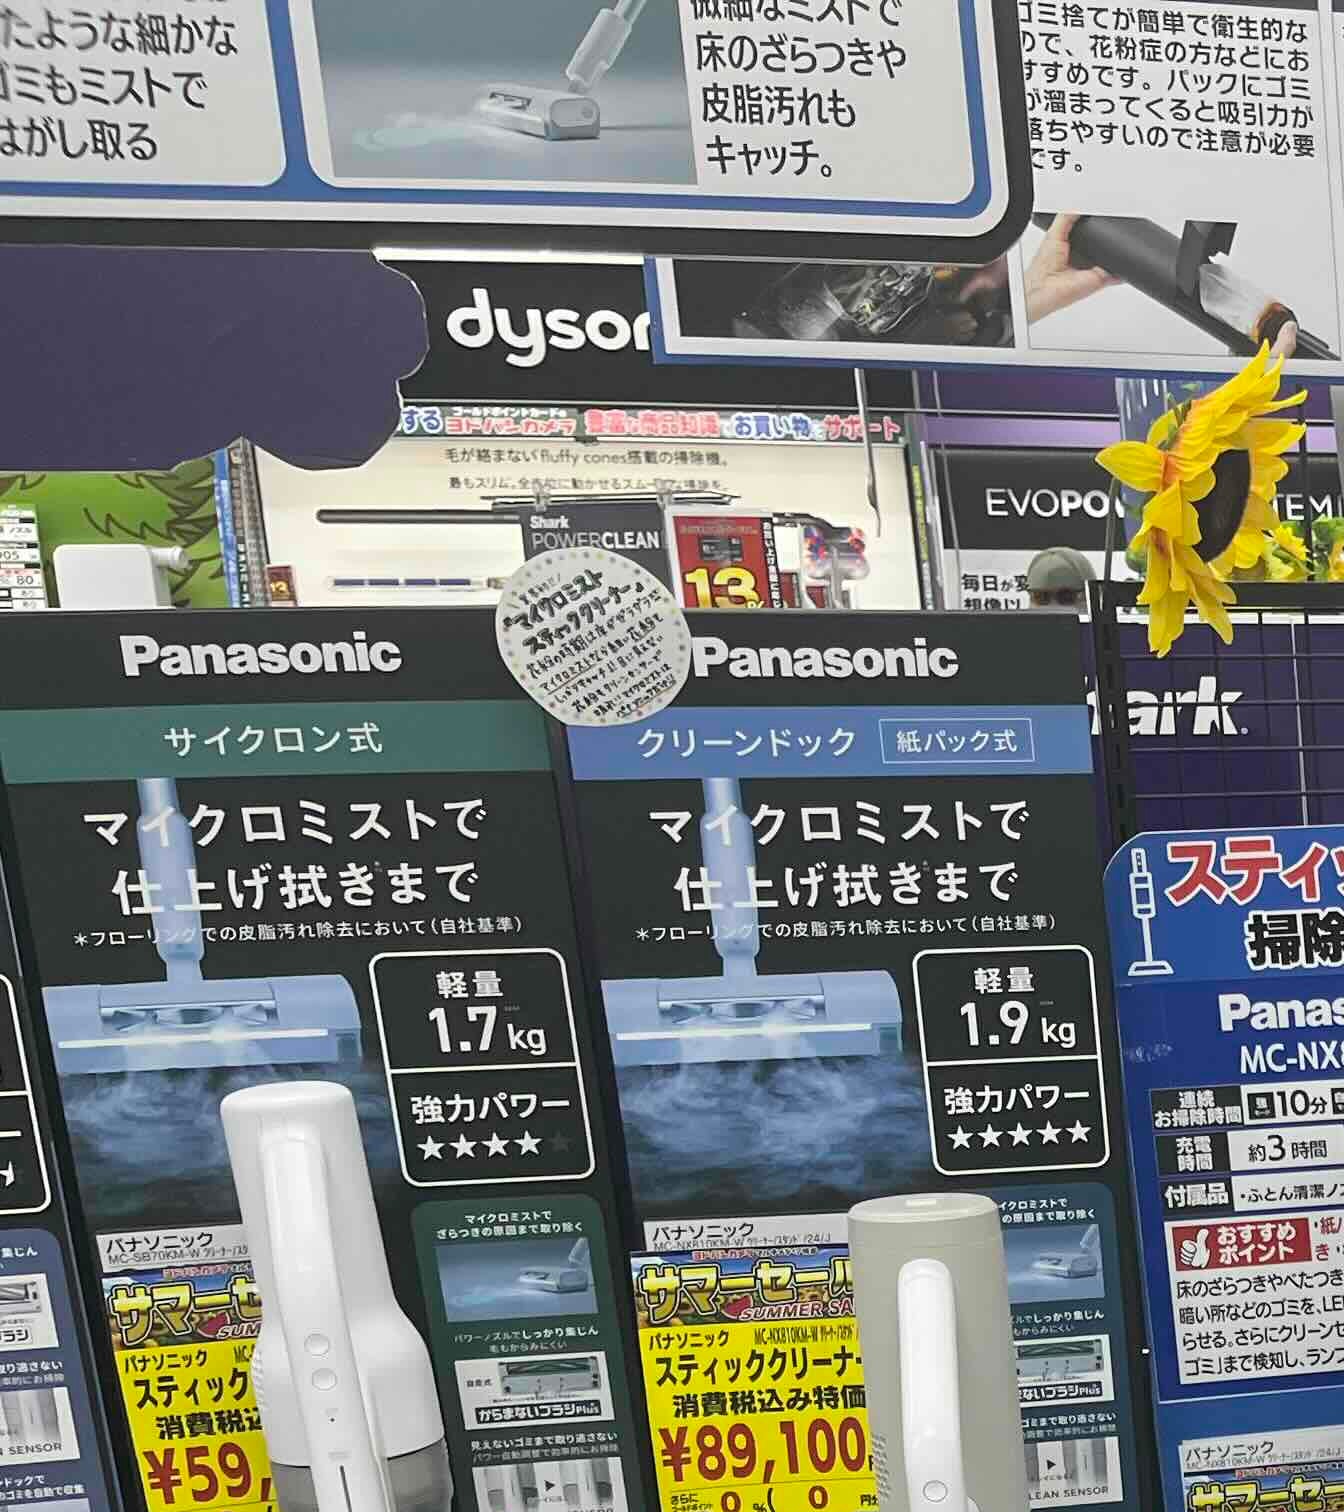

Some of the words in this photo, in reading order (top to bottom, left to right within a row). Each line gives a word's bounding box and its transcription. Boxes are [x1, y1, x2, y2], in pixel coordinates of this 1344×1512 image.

[697, 34, 906, 79] 床のざらつきや
[702, 83, 856, 128] 皮脂汚れも
[707, 135, 833, 179] キャッチ。
[119, 632, 402, 678] Panasonic
[692, 637, 959, 679] Panasonic
[163, 722, 383, 757] サイクロン式
[637, 726, 856, 759] クリーンドック
[896, 726, 1018, 753] 紙パック式
[83, 798, 489, 849] マイクロミストで
[648, 800, 1029, 845] マイクロミストで
[112, 860, 480, 917] 仕上げ拭きまで
[673, 861, 1019, 912] 仕上げ拭きまで
[436, 970, 504, 998] 軽量
[973, 966, 1035, 994] 軽量
[428, 1005, 500, 1053] 1.7
[508, 1023, 546, 1056] kg
[959, 1000, 1030, 1047] 1.9
[1040, 1017, 1075, 1047] kg
[411, 1092, 570, 1124] 強力パワー
[943, 1086, 1090, 1115] 強力パワー
[1178, 1091, 1215, 1109] 連続
[1154, 1106, 1243, 1128] お掃除時間
[1175, 1137, 1213, 1154] 充電
[1176, 1154, 1213, 1171] 時間
[1247, 1134, 1327, 1162] 約3時間
[1164, 1184, 1229, 1208] 付属品
[465, 1210, 552, 1223] マイクロミストで
[652, 1220, 753, 1240] パナソニック
[105, 1231, 214, 1252] パナソニック
[1217, 1224, 1297, 1245] おすすめ
[1218, 1243, 1296, 1265] ポイント
[648, 1329, 730, 1351] パナソニック
[123, 1352, 208, 1373] パナソニック
[661, 1416, 866, 1483] ¥89,100
[1185, 1440, 1275, 1460] パナソニック
